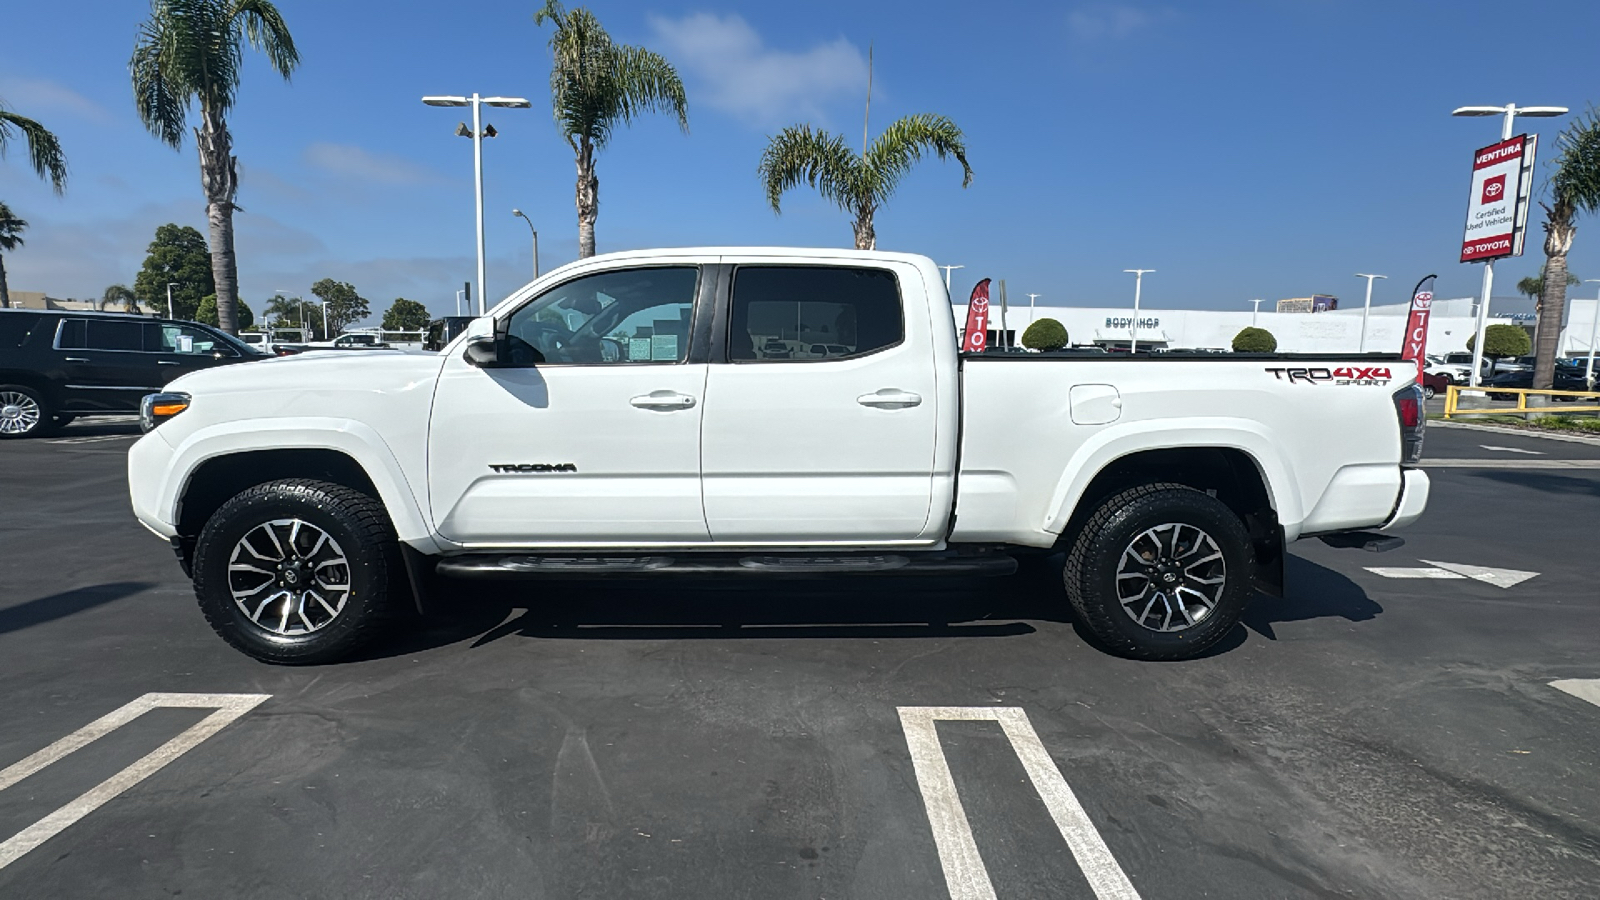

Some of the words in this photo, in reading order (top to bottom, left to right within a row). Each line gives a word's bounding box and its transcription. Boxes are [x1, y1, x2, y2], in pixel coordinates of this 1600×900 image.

[1476, 143, 1521, 164] VENTURA
[1475, 206, 1505, 219] Certified
[1466, 220, 1483, 230] Used
[1485, 216, 1512, 227] Vehicles
[1475, 239, 1510, 252] TOYOTA
[971, 316, 984, 352] TO
[1265, 368, 1333, 385] TRD
[488, 463, 578, 473] TACOMA
